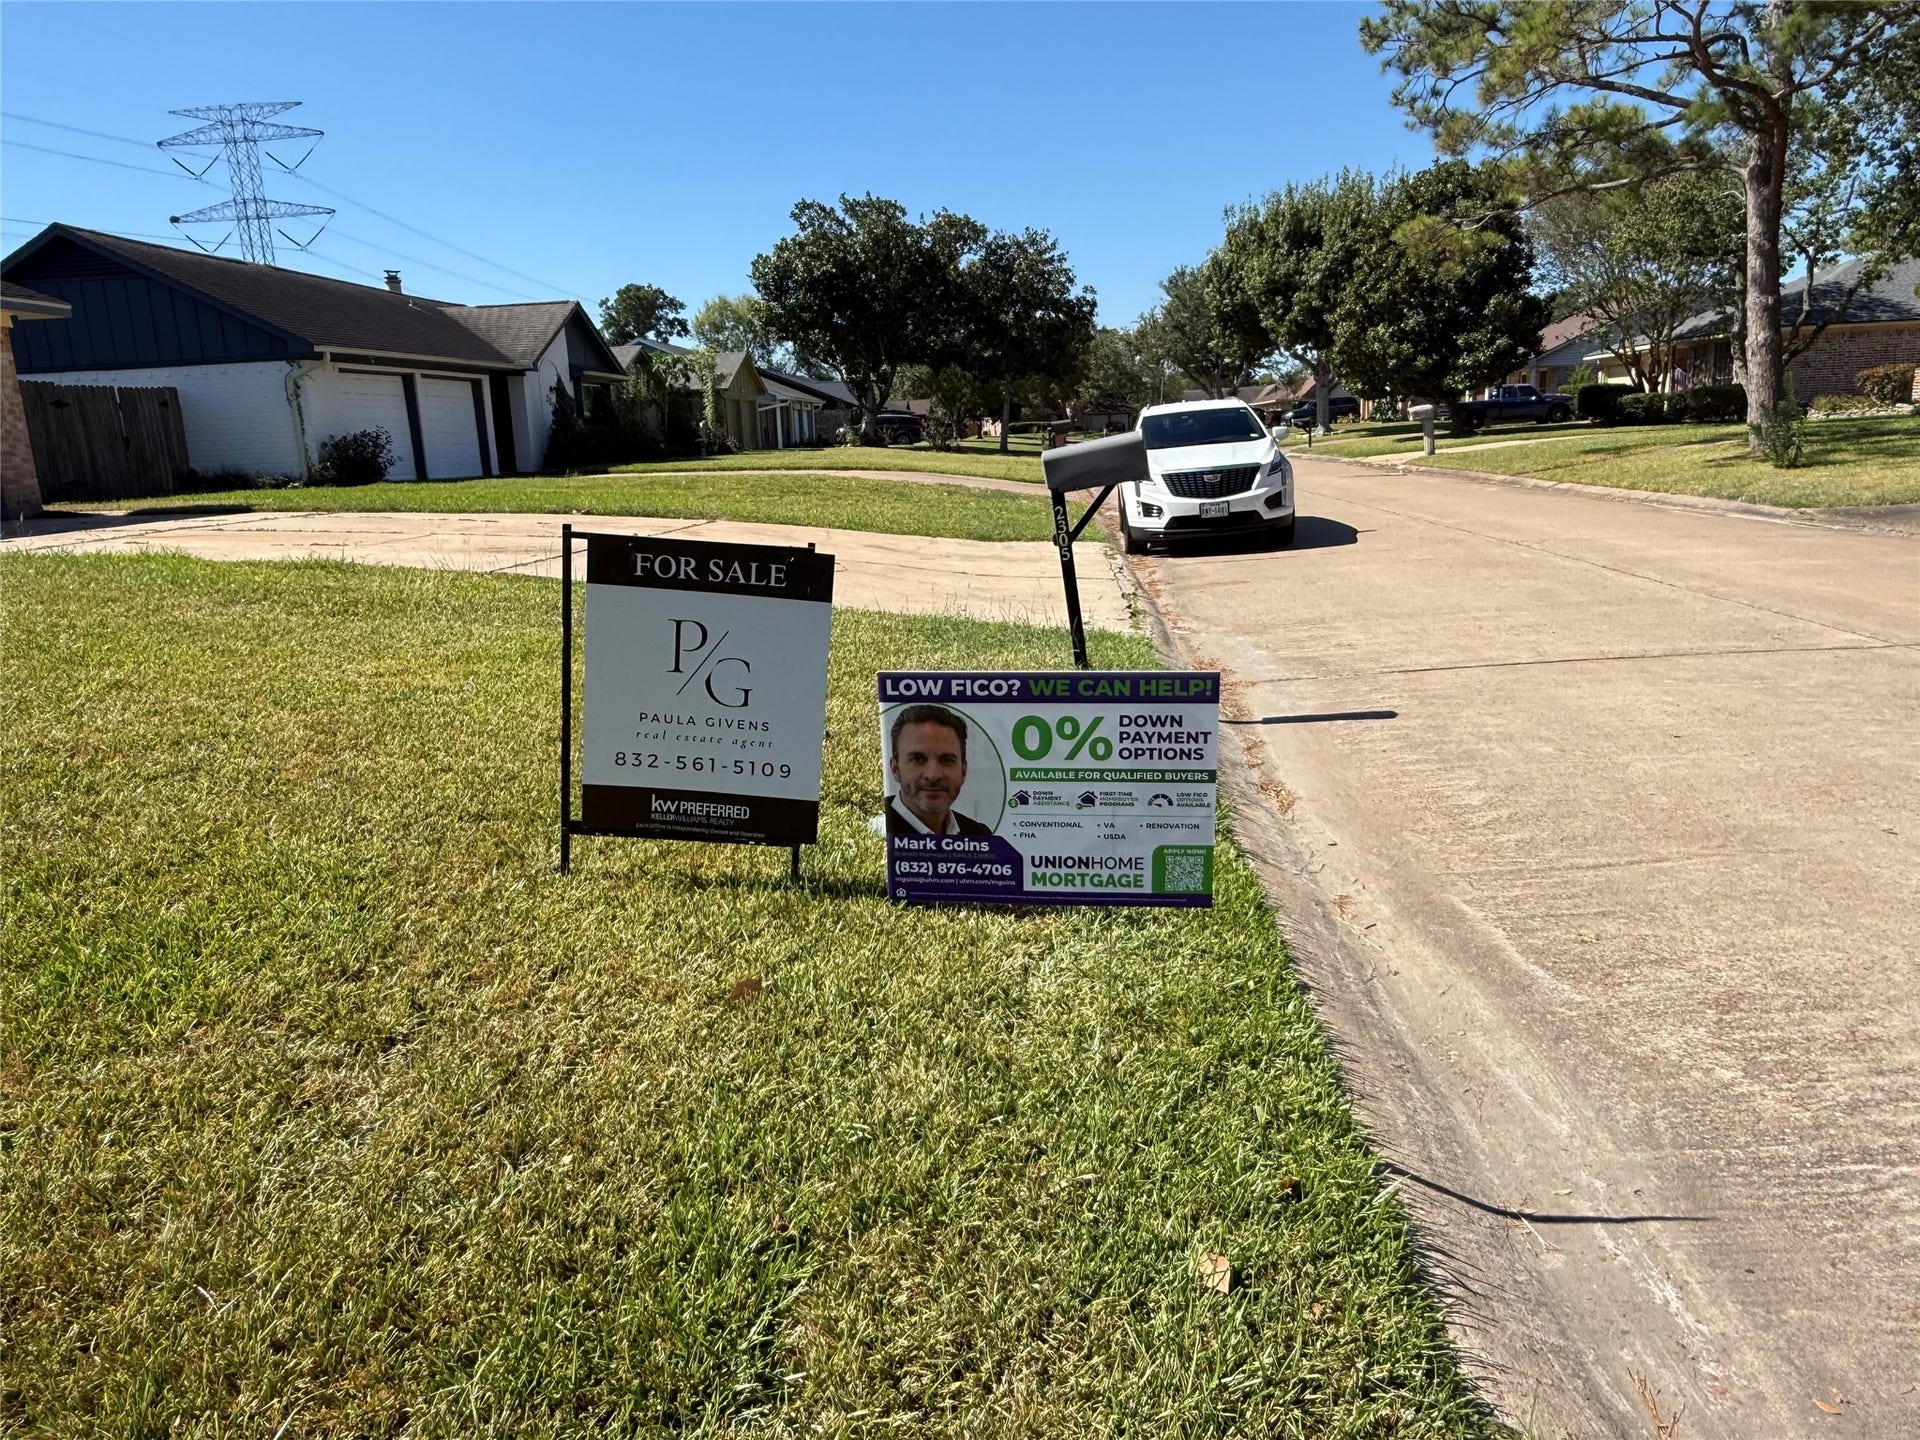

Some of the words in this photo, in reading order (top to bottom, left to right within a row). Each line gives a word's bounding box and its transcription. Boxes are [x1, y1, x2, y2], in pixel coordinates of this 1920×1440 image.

[1055, 505, 1071, 561] 2305
[633, 553, 700, 580] FOR
[708, 558, 788, 587] SALE
[885, 679, 944, 696] LOW
[950, 679, 1021, 696] FICO?
[1028, 679, 1071, 696] WE
[1077, 679, 1131, 697] CAN
[1139, 679, 1213, 697] HELP!
[639, 712, 697, 726] PAULA
[705, 716, 770, 732] GIVENS
[1118, 714, 1183, 728] DOWN
[635, 730, 667, 740] real
[675, 734, 723, 744] estate
[732, 739, 773, 749] agent
[1011, 715, 1113, 761] 0%
[1118, 731, 1212, 745] PAYMENT
[1118, 747, 1205, 761] OPTIONS
[614, 751, 792, 779] 832-561-5109
[1015, 770, 1075, 779] AVAILABLE
[1078, 771, 1101, 780] FOR
[1103, 771, 1162, 781] QUALIFIED
[1164, 772, 1209, 781] BUYERS
[651, 793, 679, 812] kw
[680, 801, 750, 819] PREFERRED
[710, 818, 735, 826] REALTY
[1019, 820, 1083, 829] CONVENTIONAL
[1146, 822, 1200, 830] RENOVATION
[894, 836, 937, 850] Mark
[941, 838, 990, 852] Goins
[895, 860, 933, 876] (832)
[937, 862, 1013, 876] 876-4706
[1031, 871, 1145, 888] MORTGAGE
